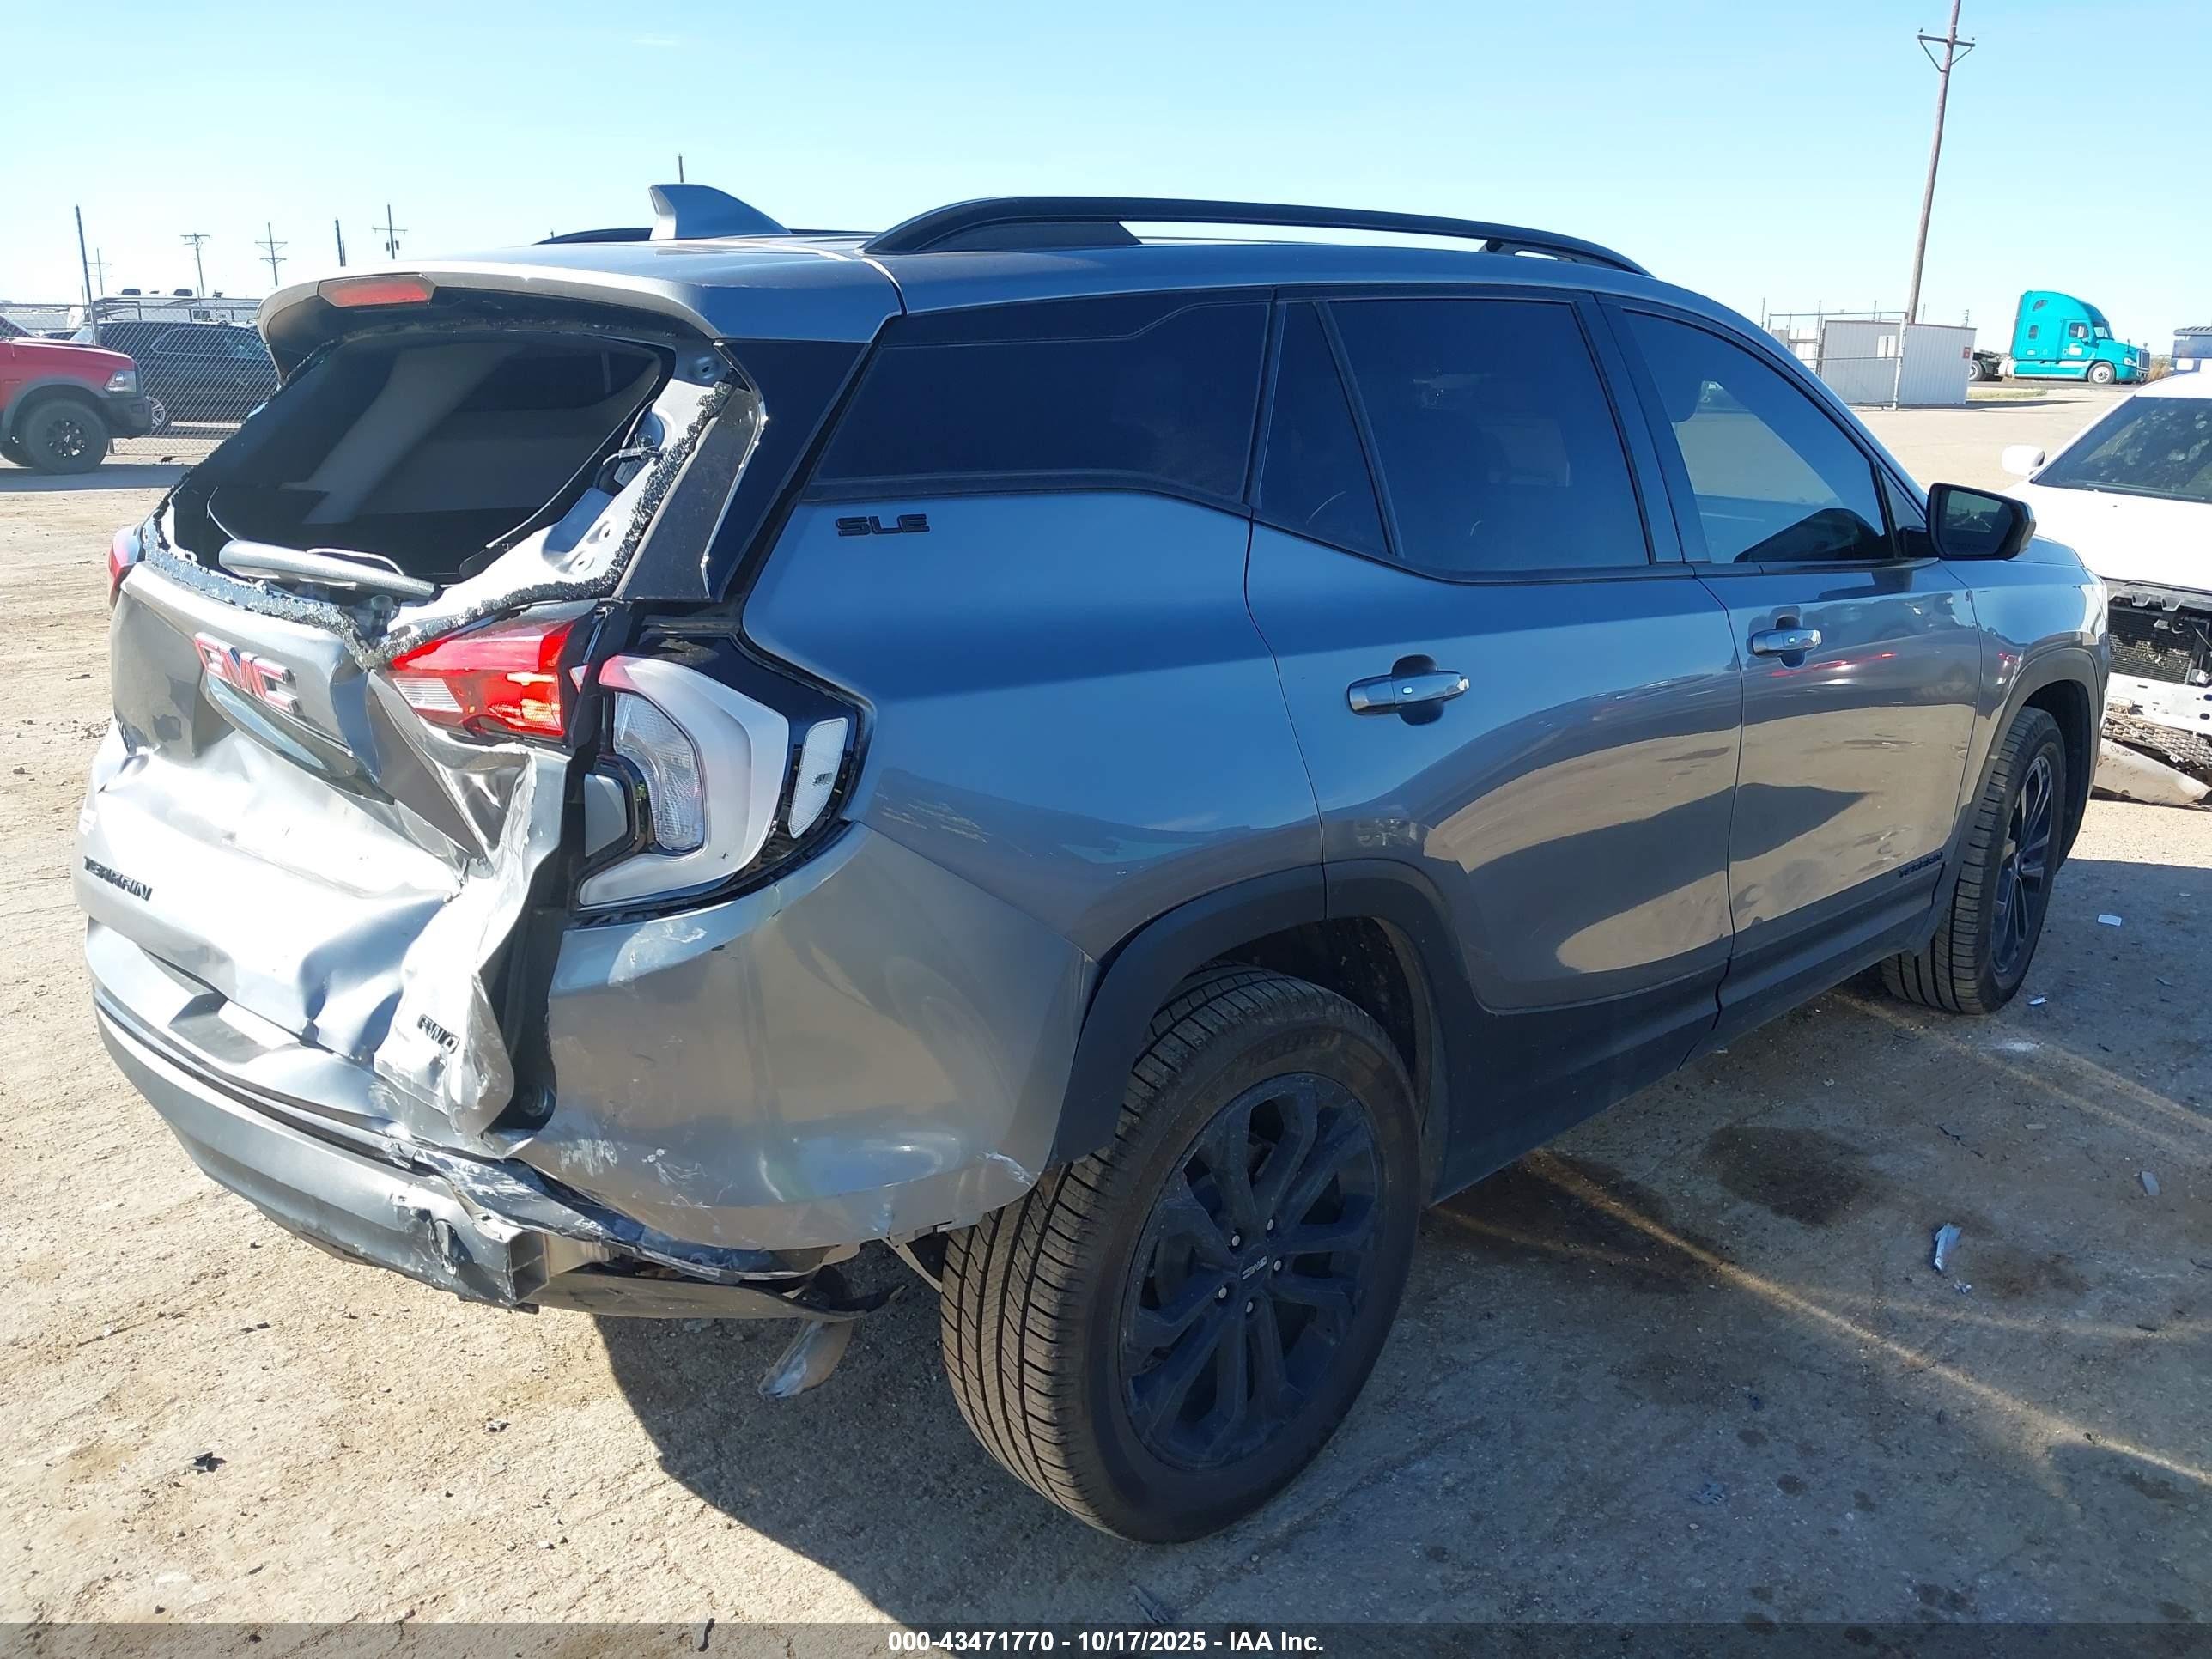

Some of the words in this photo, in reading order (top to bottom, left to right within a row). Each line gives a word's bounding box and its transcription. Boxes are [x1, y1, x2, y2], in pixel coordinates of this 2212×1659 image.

[836, 514, 930, 537] SLE
[193, 632, 300, 714] GMC
[83, 855, 153, 902] TERRAIN
[1242, 1255, 1267, 1280] GMC
